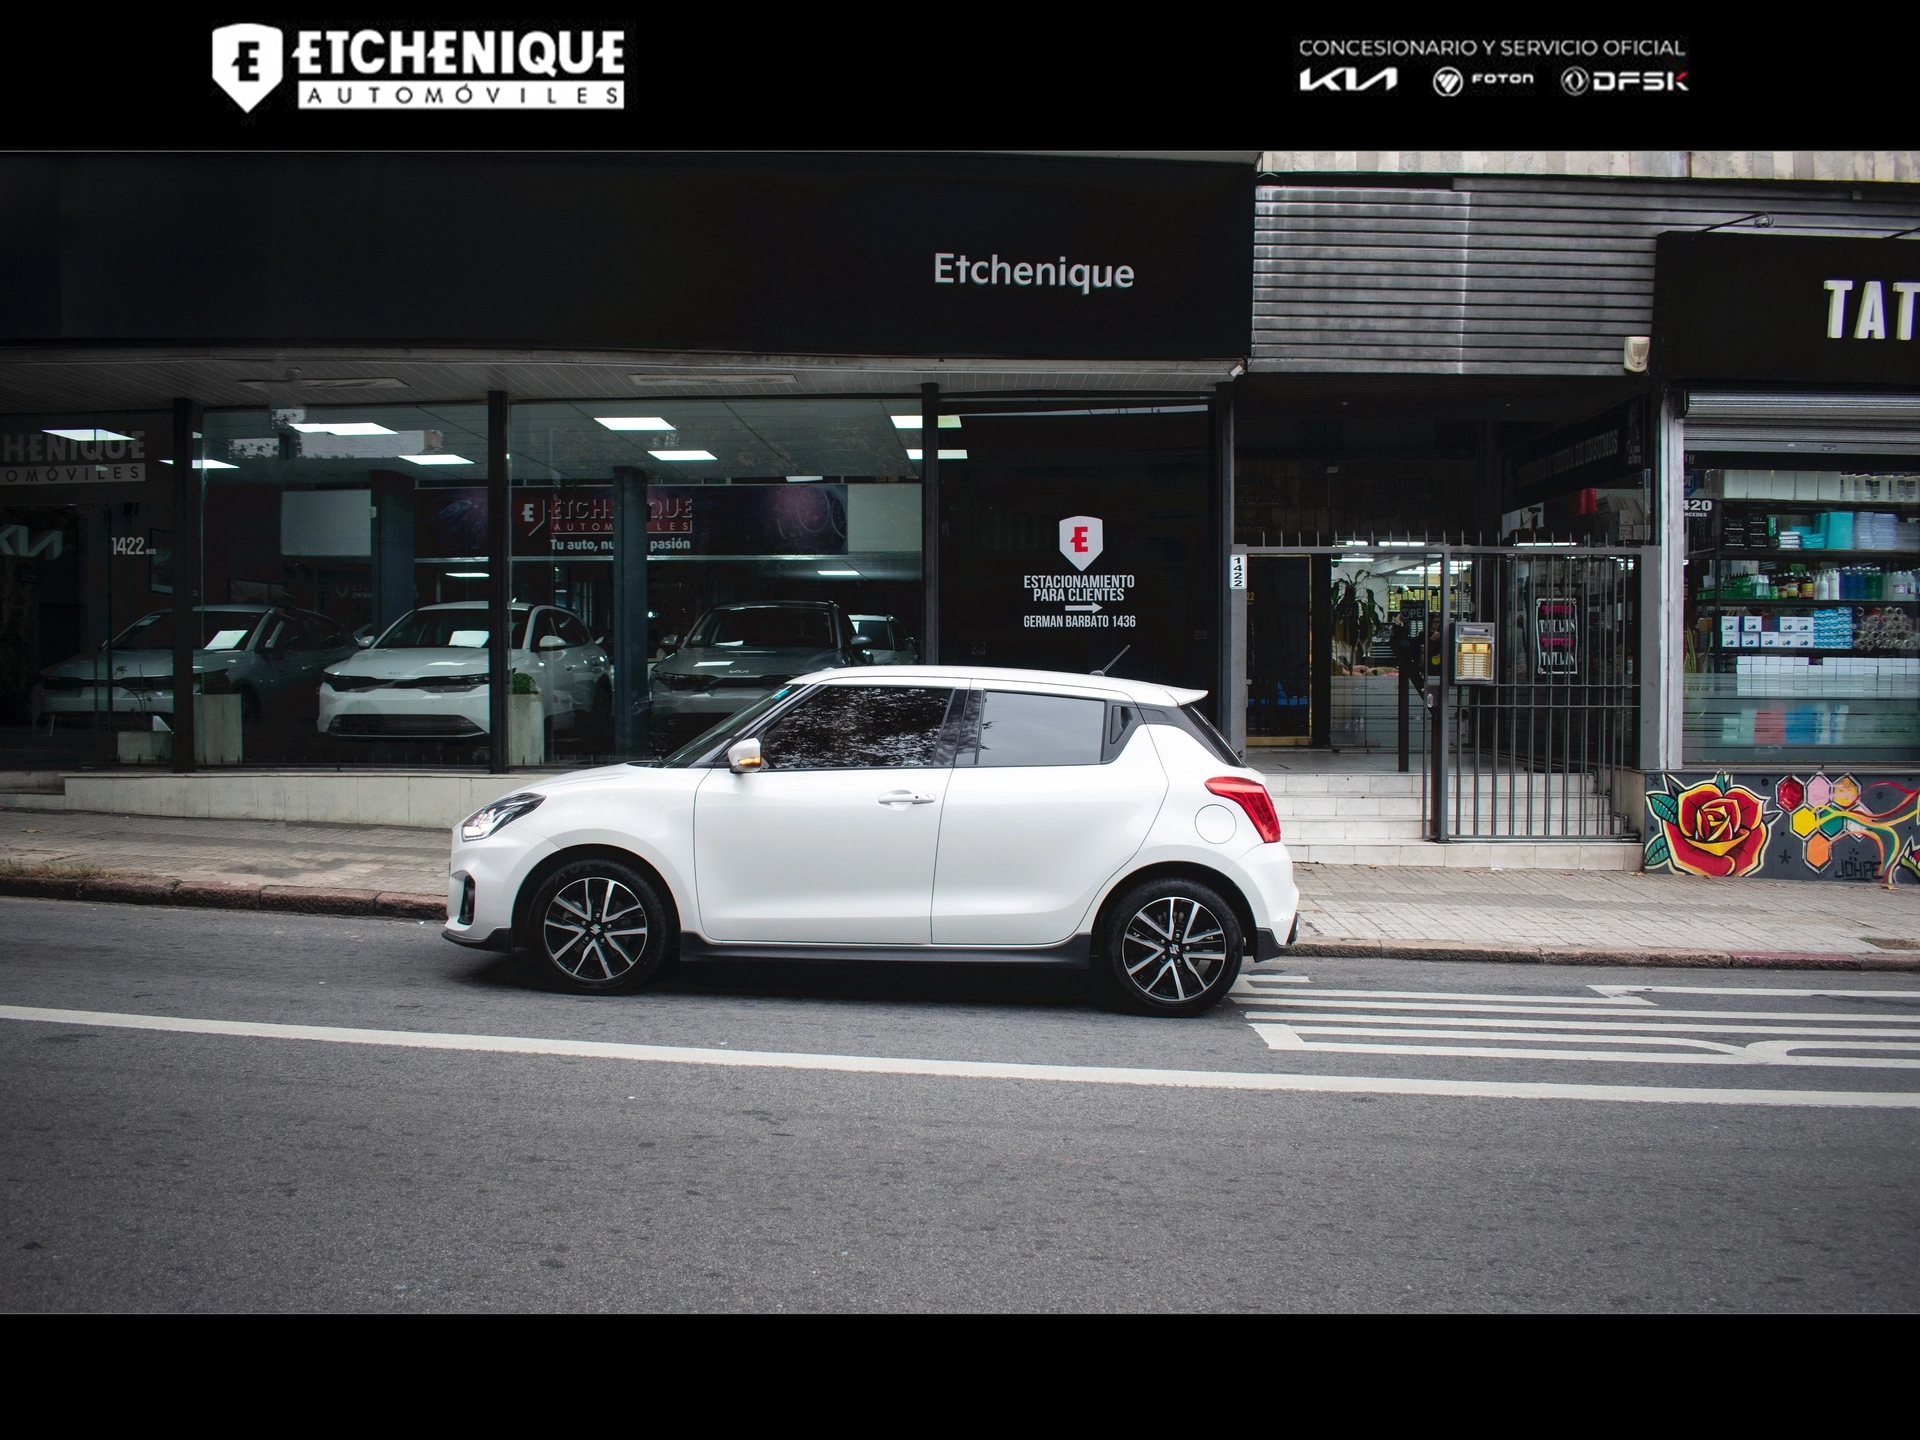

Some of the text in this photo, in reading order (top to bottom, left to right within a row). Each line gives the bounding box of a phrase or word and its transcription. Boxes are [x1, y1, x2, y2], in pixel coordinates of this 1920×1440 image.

[934, 252, 1135, 295] Etchenique
[1823, 280, 1920, 340] TAT
[547, 498, 693, 520] ETCHQUE
[553, 522, 689, 532] AUTOMLES
[112, 536, 145, 555] 1422
[550, 539, 564, 550] Tu
[567, 539, 598, 552] auto,
[649, 537, 691, 552] pasión
[1233, 556, 1243, 588] 1422
[1023, 574, 1136, 589] ESTACIONAMIENTO
[1033, 588, 1125, 602] PARA CLIENTES
[1023, 615, 1136, 628] GERMAN BARBATO 1436
